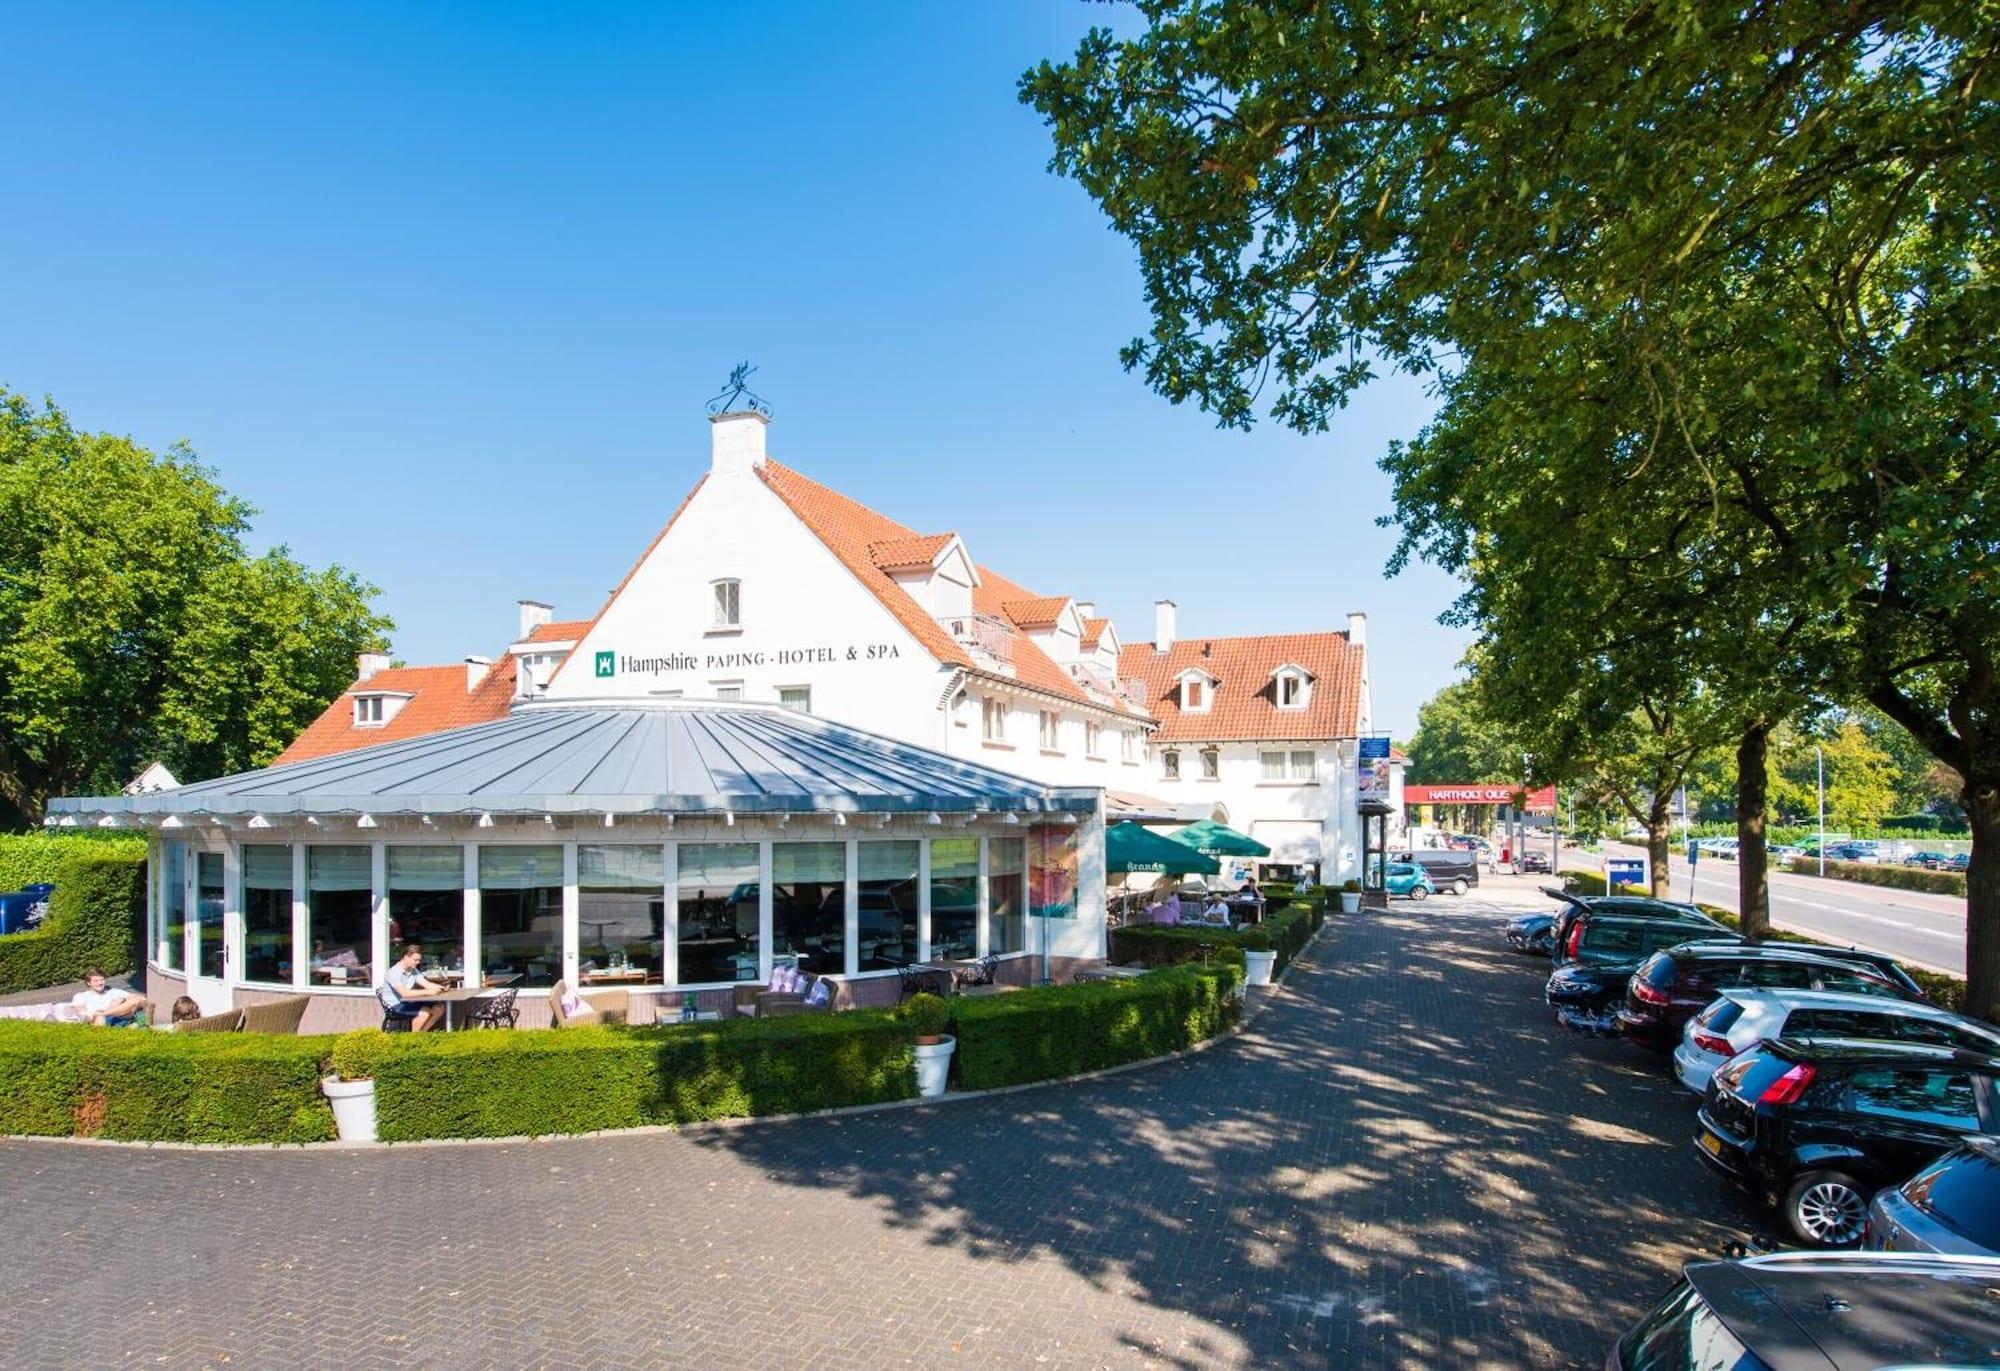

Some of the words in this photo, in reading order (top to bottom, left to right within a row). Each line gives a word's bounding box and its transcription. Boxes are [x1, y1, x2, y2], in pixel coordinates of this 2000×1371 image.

[620, 652, 698, 676] Hampshire
[707, 653, 765, 668] PAPING
[778, 648, 837, 664] HOTEL
[846, 645, 858, 660] &
[866, 645, 900, 660] SPA
[1428, 790, 1481, 800] HARTHOLT
